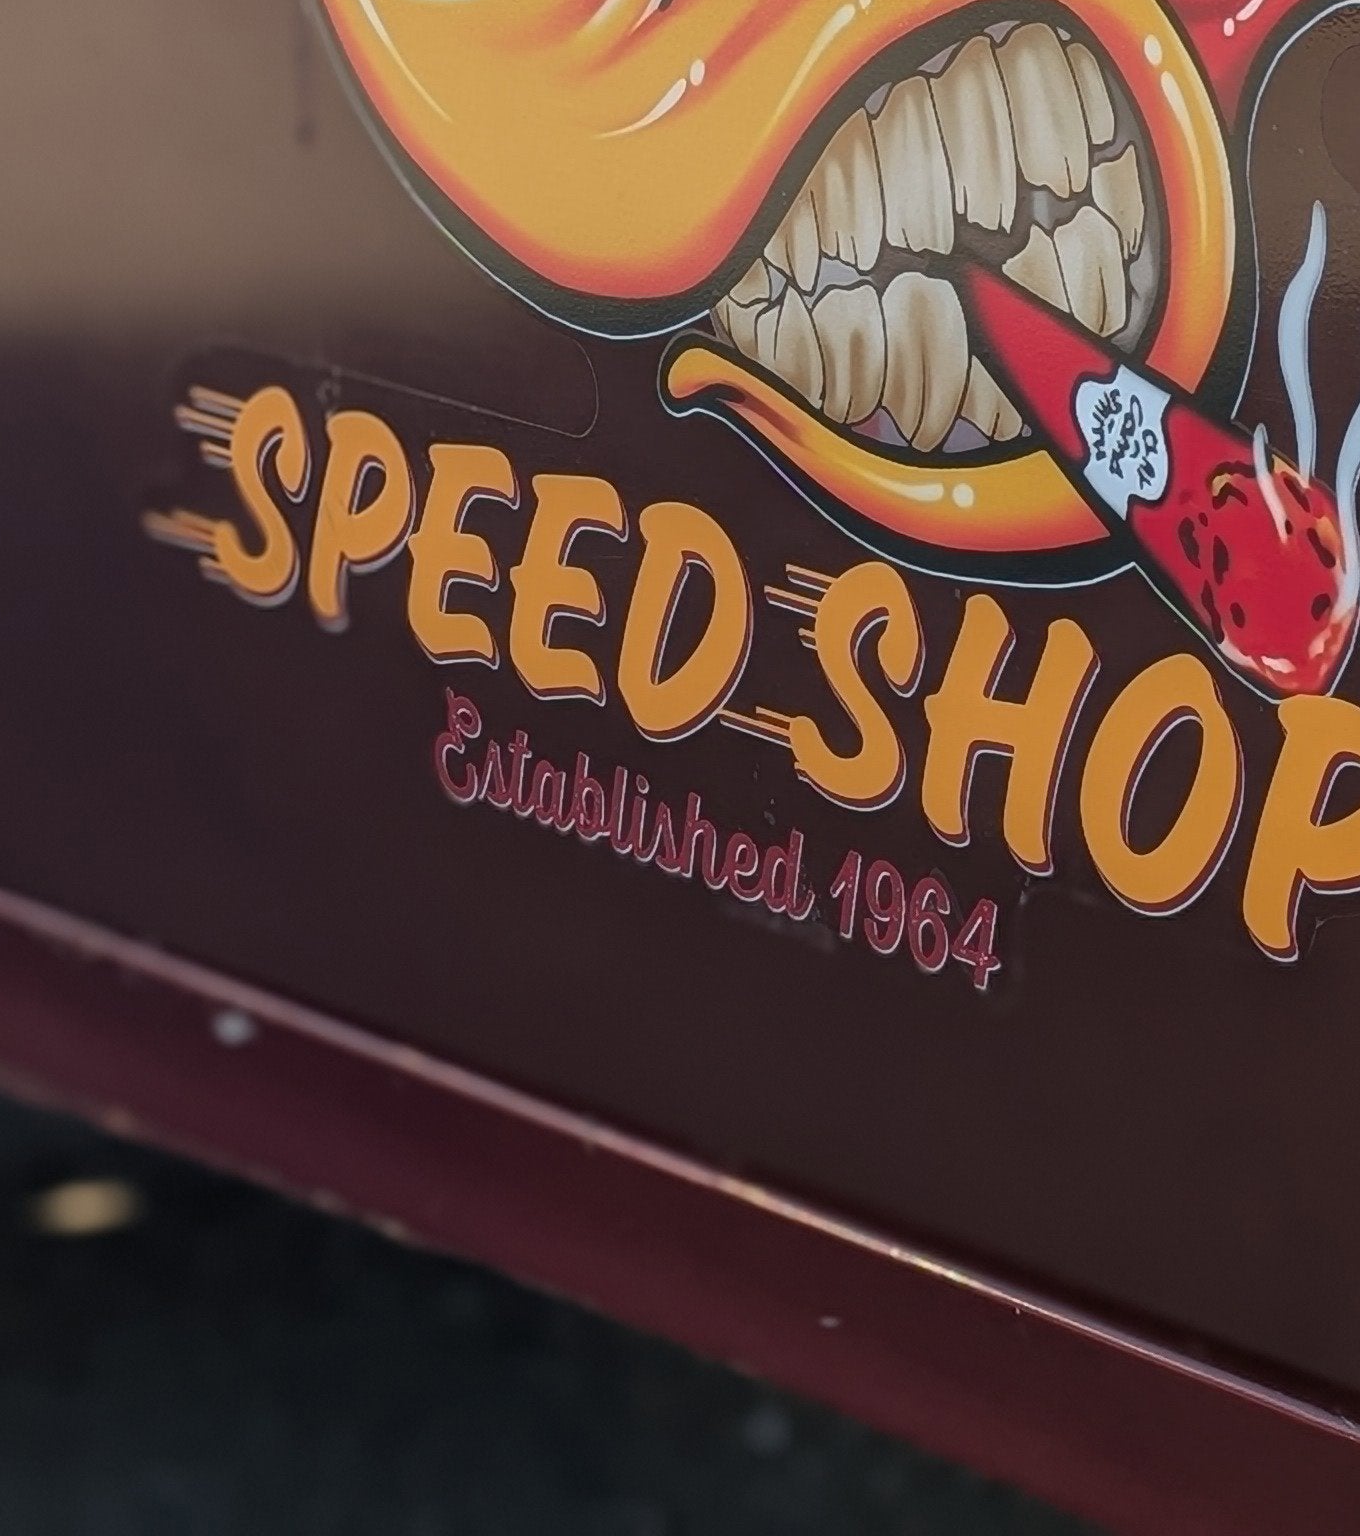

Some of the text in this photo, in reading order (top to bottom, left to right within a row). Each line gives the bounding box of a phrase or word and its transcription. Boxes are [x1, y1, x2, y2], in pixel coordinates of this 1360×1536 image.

[196, 385, 753, 743] SPEED
[437, 686, 1000, 990] Established 1964
